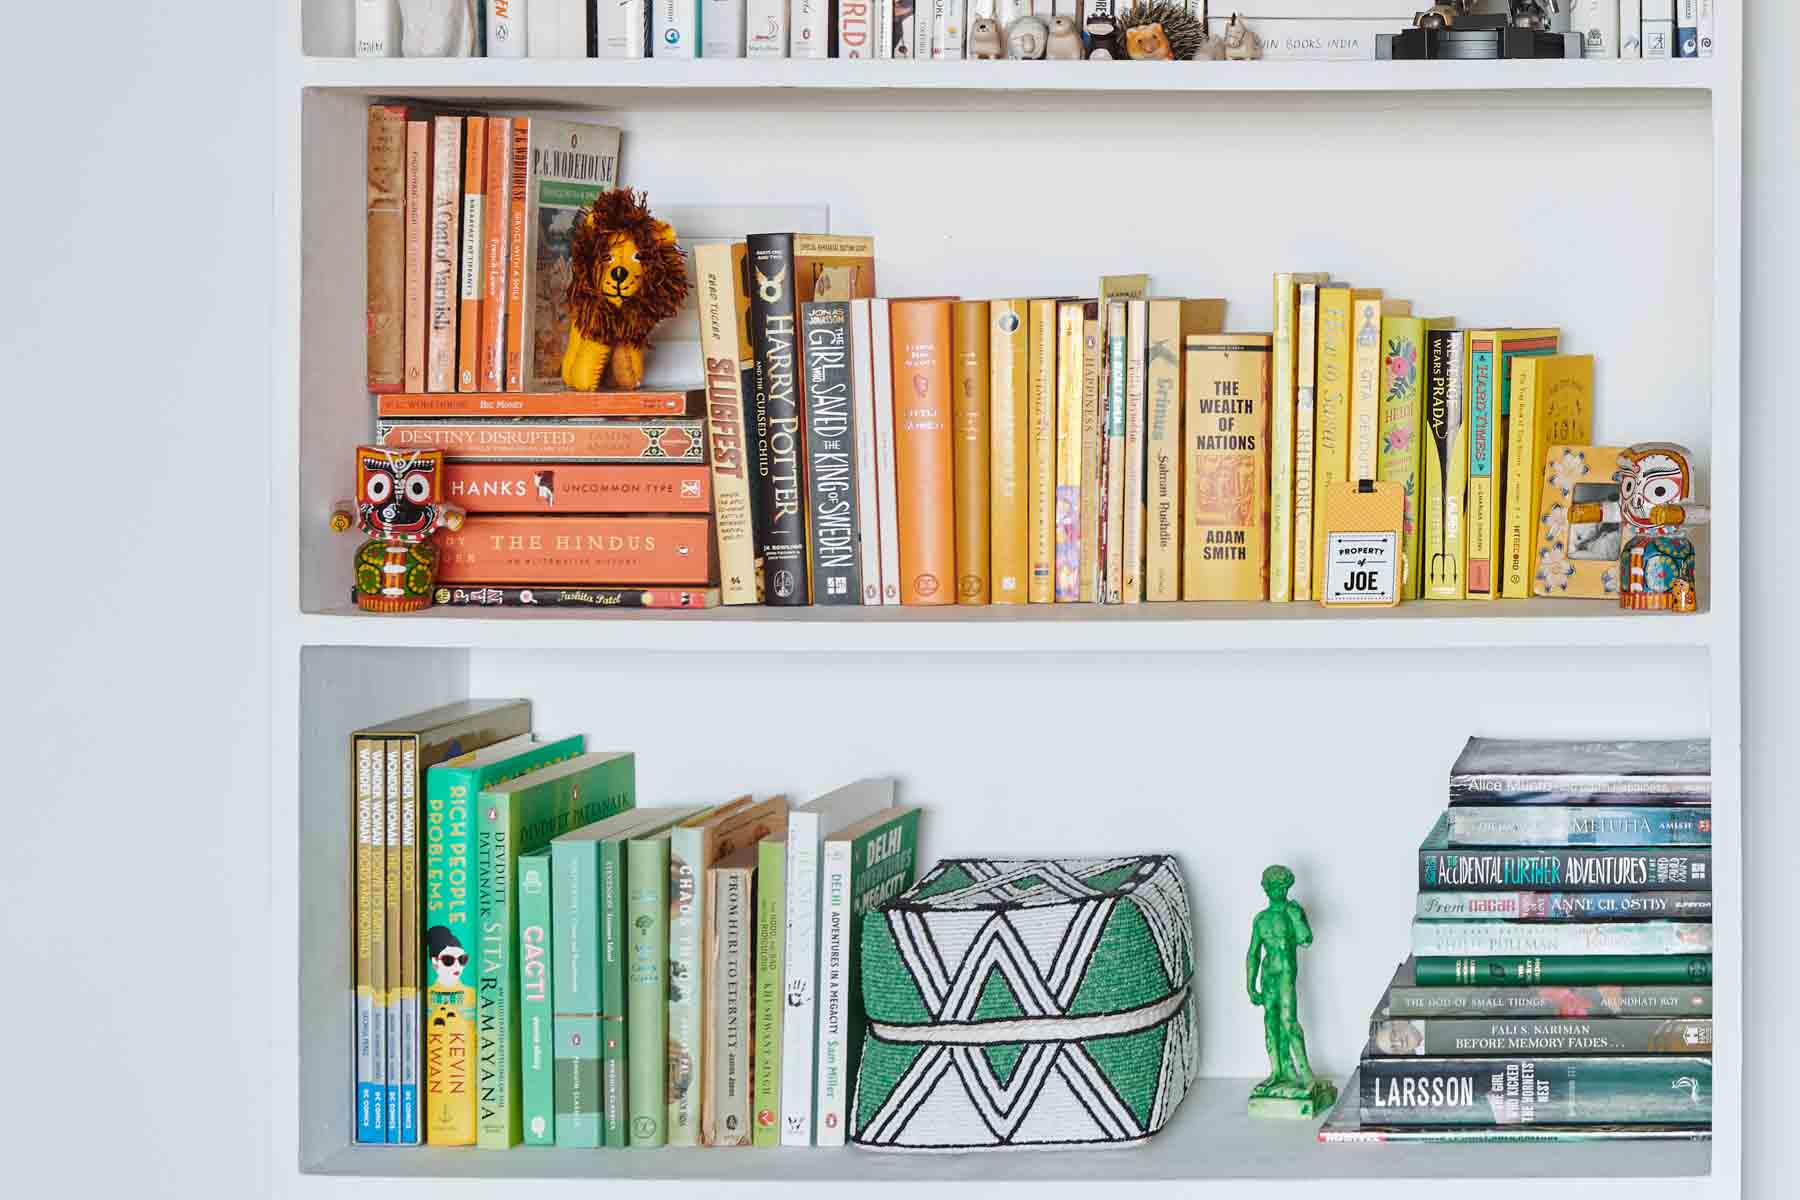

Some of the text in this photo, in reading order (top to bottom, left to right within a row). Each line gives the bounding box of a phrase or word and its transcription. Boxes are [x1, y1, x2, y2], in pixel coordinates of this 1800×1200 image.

[1214, 381, 1239, 395] THE
[1432, 338, 1446, 428] WEARS PRADA
[766, 313, 799, 522] HARRY POTTER
[1200, 400, 1253, 414] WEALTH
[756, 392, 769, 477] CURSED CHILD
[1218, 417, 1234, 432] OF
[400, 429, 575, 445] DESTINY DISRUPTED
[808, 329, 854, 568] GIRL SAVED KING SWEDEN
[1197, 435, 1255, 450] NATIONS
[491, 535, 656, 551] THE HINDUS
[1206, 530, 1245, 544] ADAM
[1203, 546, 1246, 560] SMITH
[1339, 547, 1384, 556] PROPERTY
[1344, 571, 1378, 591] JOE
[428, 800, 444, 912] PROBLEMS
[448, 785, 466, 924] RICH PEOPLE
[1438, 856, 1648, 885] ACCIDENTAL FURTHER ADVENTURES
[524, 926, 545, 1001] CACTI
[1534, 1023, 1590, 1034] NARIMAN
[428, 1033, 443, 1094] KWAN
[448, 1032, 464, 1094] KEVIN
[1375, 1076, 1473, 1107] LARSSON
